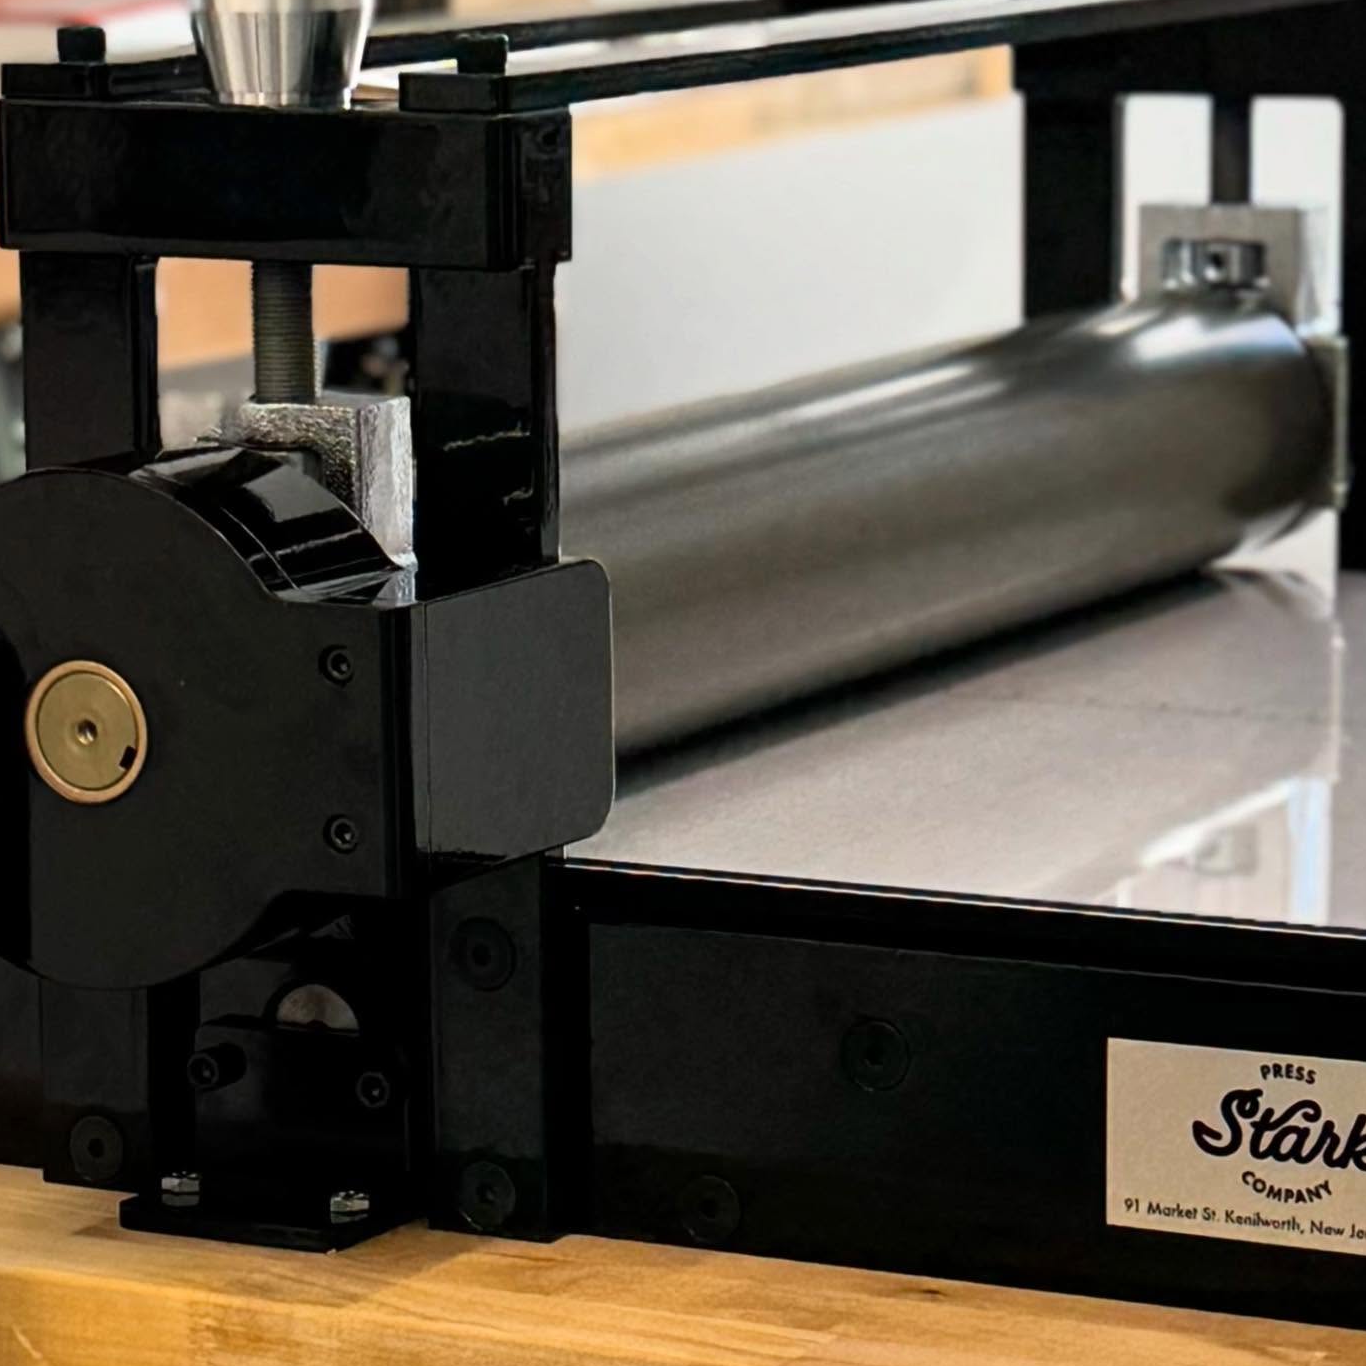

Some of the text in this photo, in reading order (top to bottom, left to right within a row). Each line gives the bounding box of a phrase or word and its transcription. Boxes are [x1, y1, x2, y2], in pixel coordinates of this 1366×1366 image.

[1260, 1063, 1317, 1084] PRESS
[1241, 1170, 1333, 1204] COMPANY
[1124, 1198, 1140, 1212] 91
[1147, 1201, 1198, 1220] Market
[1202, 1207, 1220, 1222] St.
[1224, 1210, 1305, 1234] Kenilworth,
[1309, 1220, 1345, 1236] New
